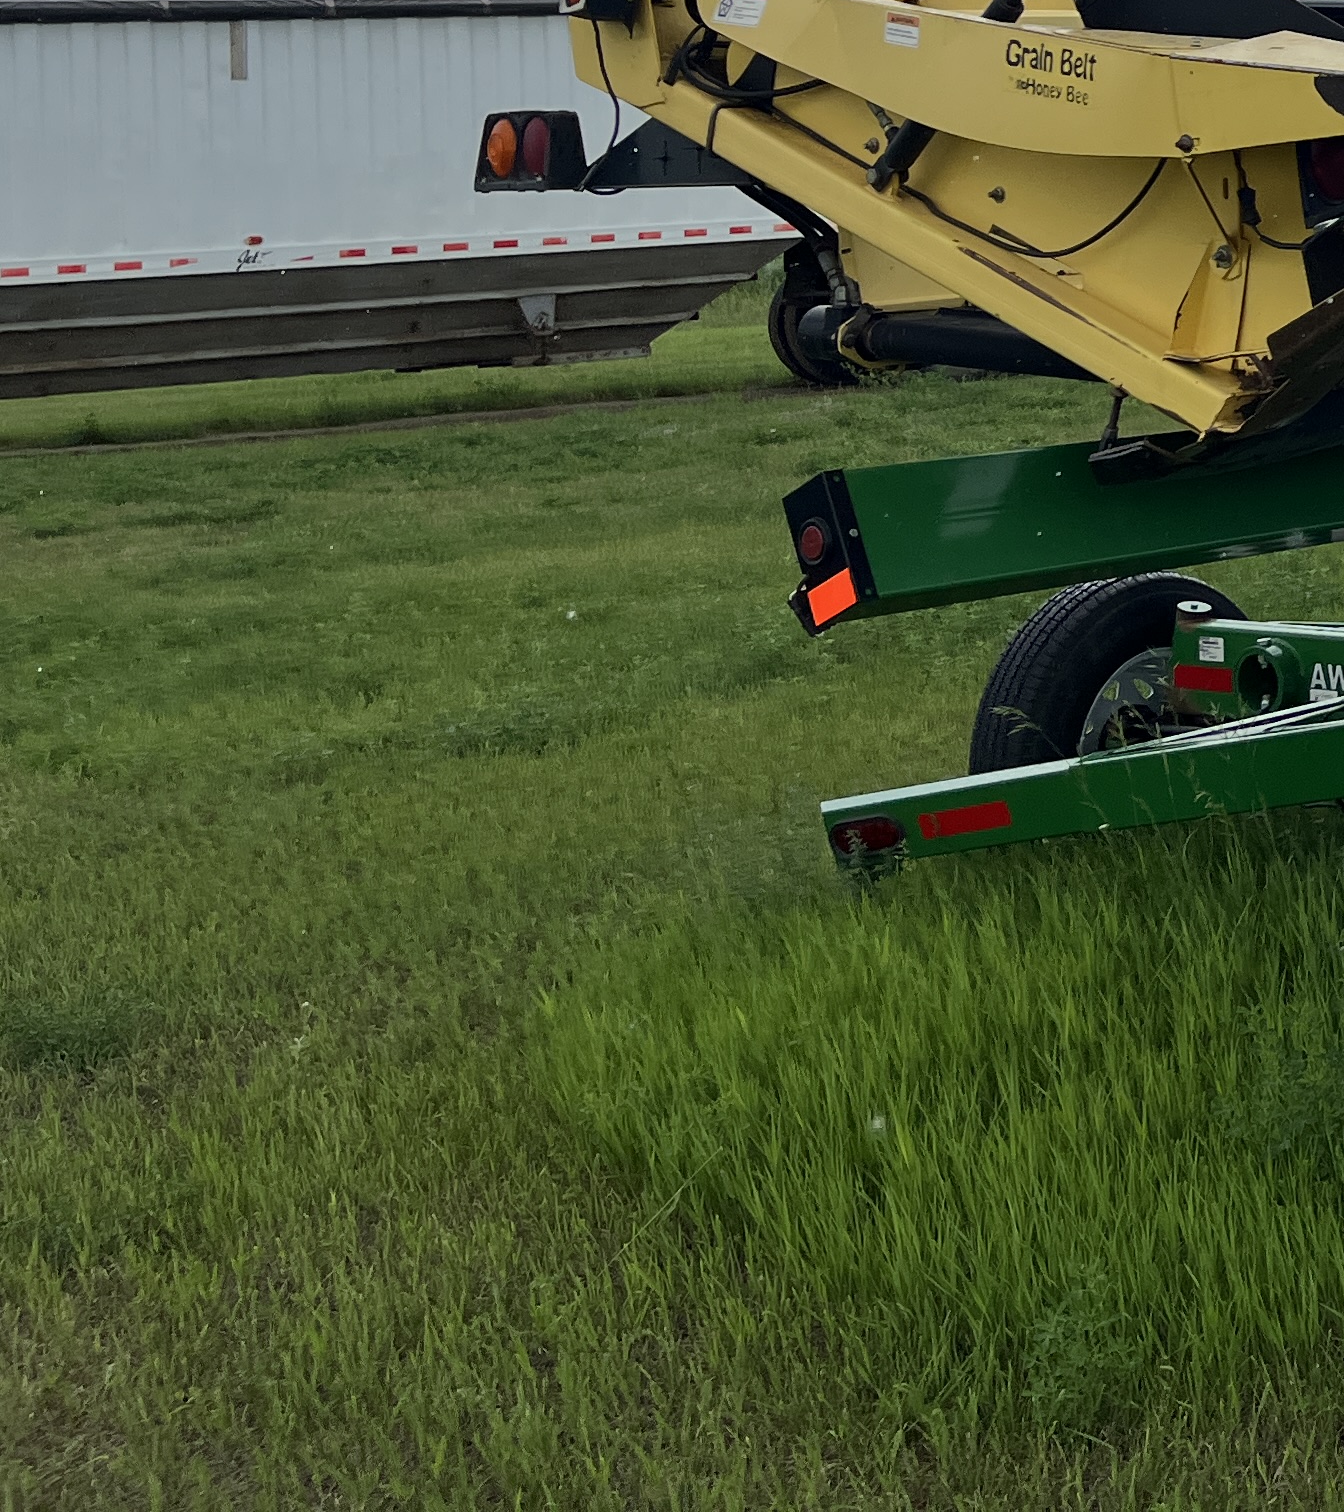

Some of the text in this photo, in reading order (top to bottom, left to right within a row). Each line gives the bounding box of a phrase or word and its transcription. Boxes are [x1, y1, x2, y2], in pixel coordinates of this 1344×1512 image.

[1005, 39, 1098, 81] Grain Belt
[1026, 77, 1063, 99] Honey
[1066, 85, 1089, 106] Bee
